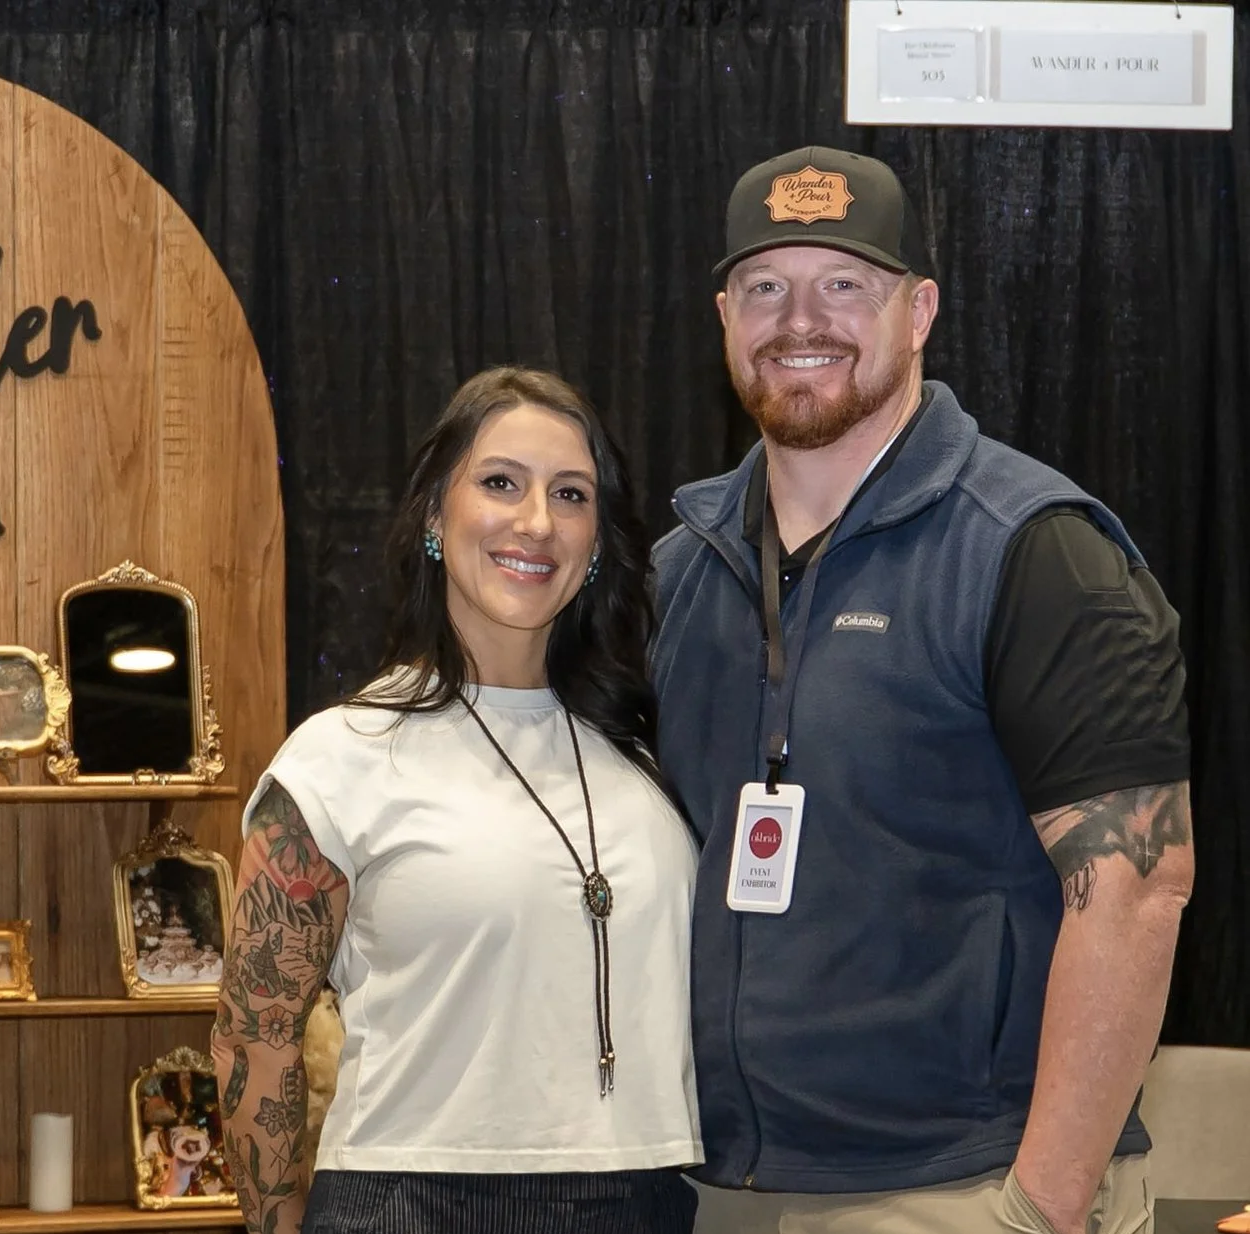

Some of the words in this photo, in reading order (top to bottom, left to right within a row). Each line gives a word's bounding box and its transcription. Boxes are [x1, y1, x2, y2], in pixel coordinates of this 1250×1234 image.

[1031, 55, 1096, 71] WANDER
[1116, 56, 1159, 71] POUR
[782, 177, 834, 191] Wander
[795, 188, 832, 203] Pour
[842, 615, 884, 628] Columbia
[750, 867, 771, 877] EVENT
[741, 878, 777, 888] EXHIBITOR
